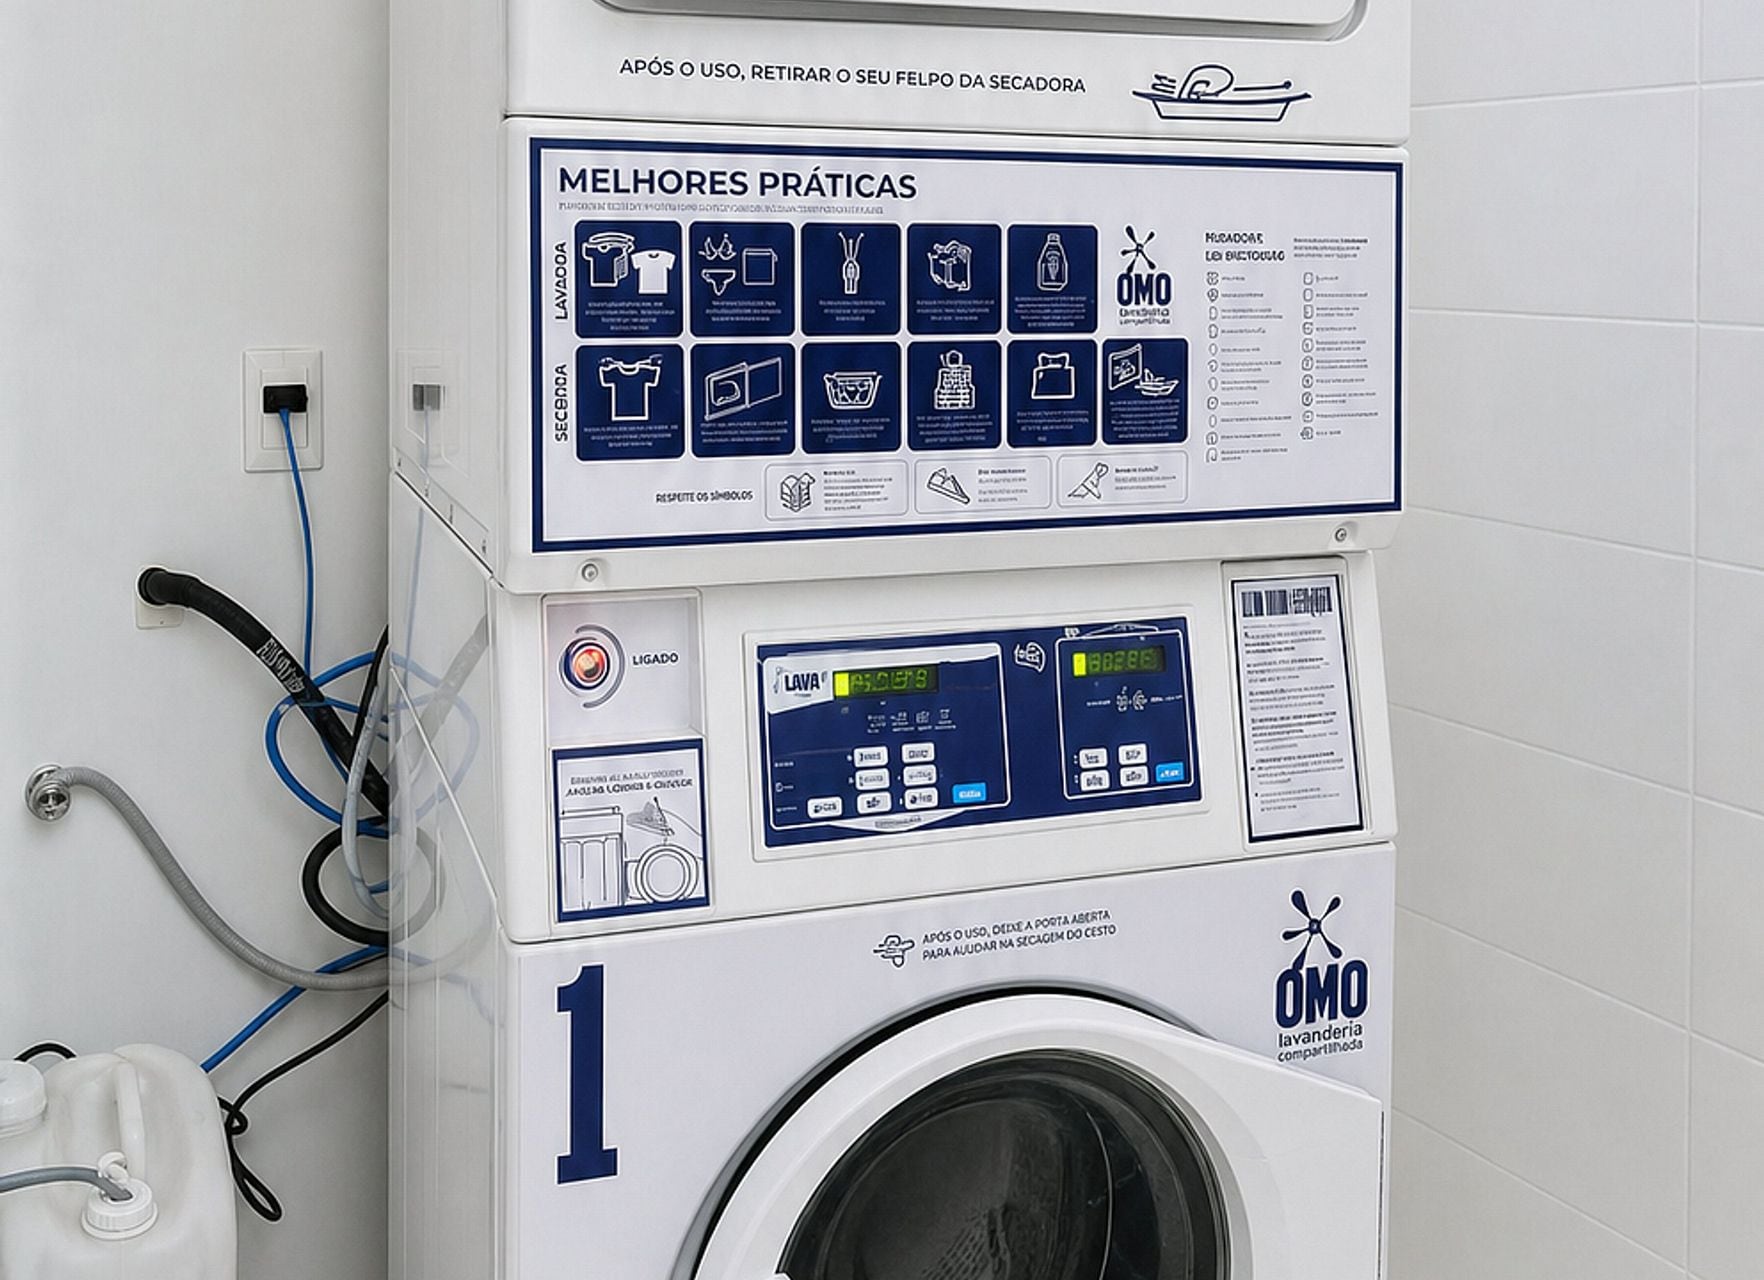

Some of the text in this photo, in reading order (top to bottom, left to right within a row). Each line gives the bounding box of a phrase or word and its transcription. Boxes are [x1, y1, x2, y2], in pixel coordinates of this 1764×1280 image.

[620, 55, 1087, 94] APÓS O USO, RETIRAR O SEU FELPO DA SECADORA
[559, 166, 918, 199] MELHORES PRÁTICAS
[1117, 272, 1171, 307] OMO
[632, 652, 678, 666] LIGADO
[1084, 924, 1117, 938] CESTO
[1276, 959, 1368, 1029] OMO
[1278, 1020, 1363, 1048] lavanderia
[557, 964, 618, 1184] 1
